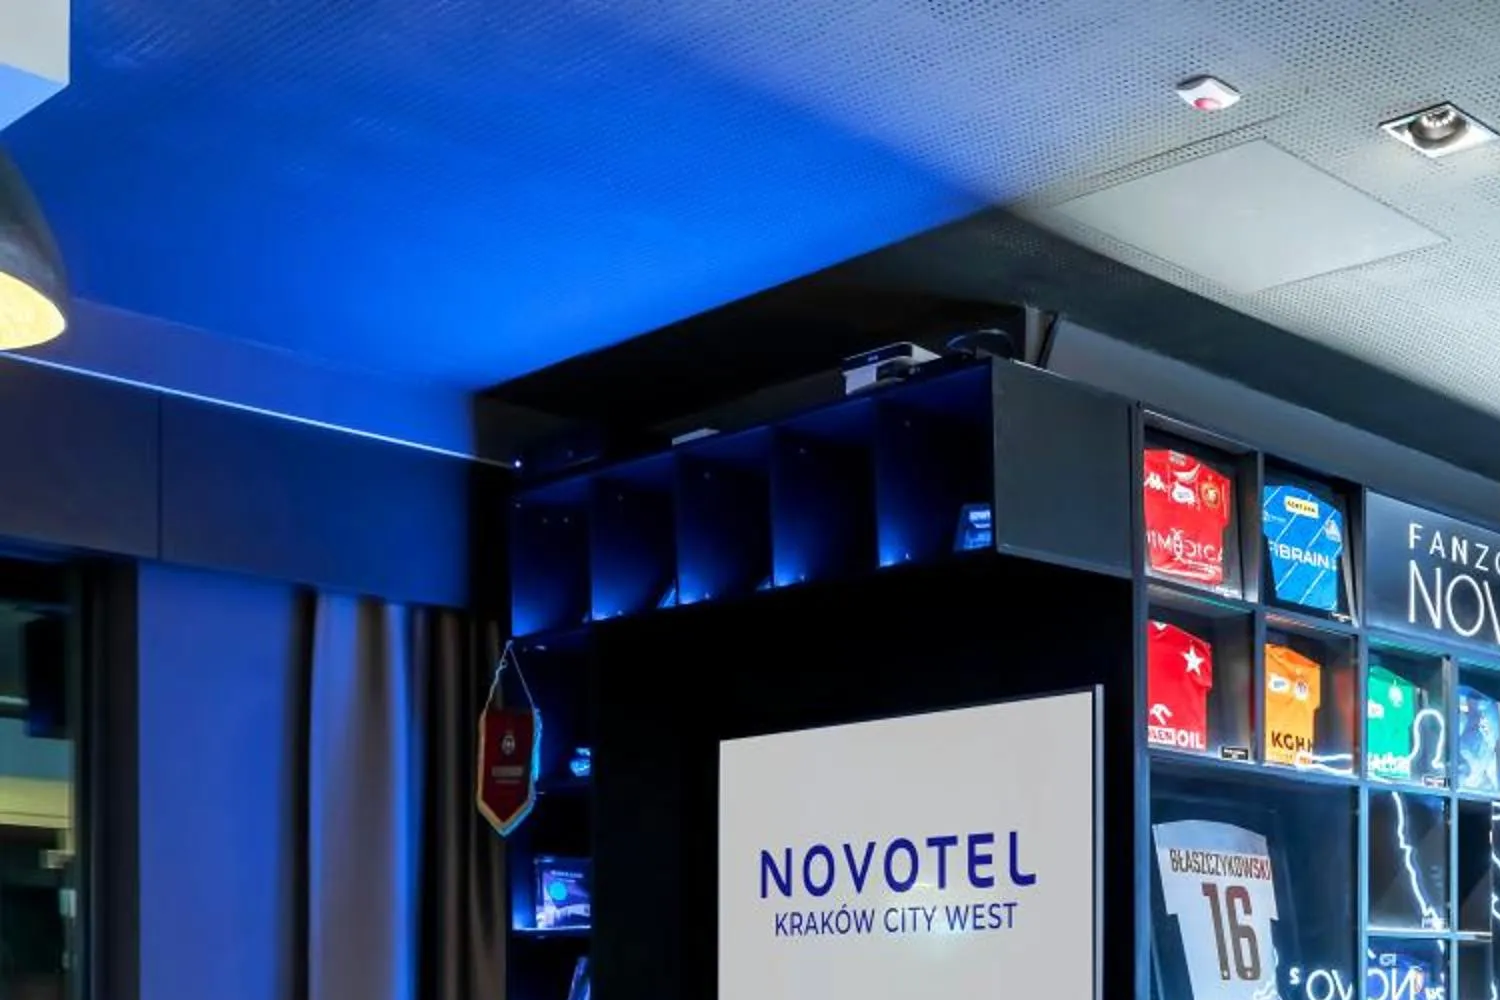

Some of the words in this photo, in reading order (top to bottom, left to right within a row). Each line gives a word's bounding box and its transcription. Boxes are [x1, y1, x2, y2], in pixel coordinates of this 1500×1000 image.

[760, 831, 1037, 899] NOVOTEL
[774, 904, 875, 937] KRAKÓW
[883, 906, 938, 933] CITY
[945, 901, 1018, 931] WEST
[1201, 882, 1261, 981] 16
